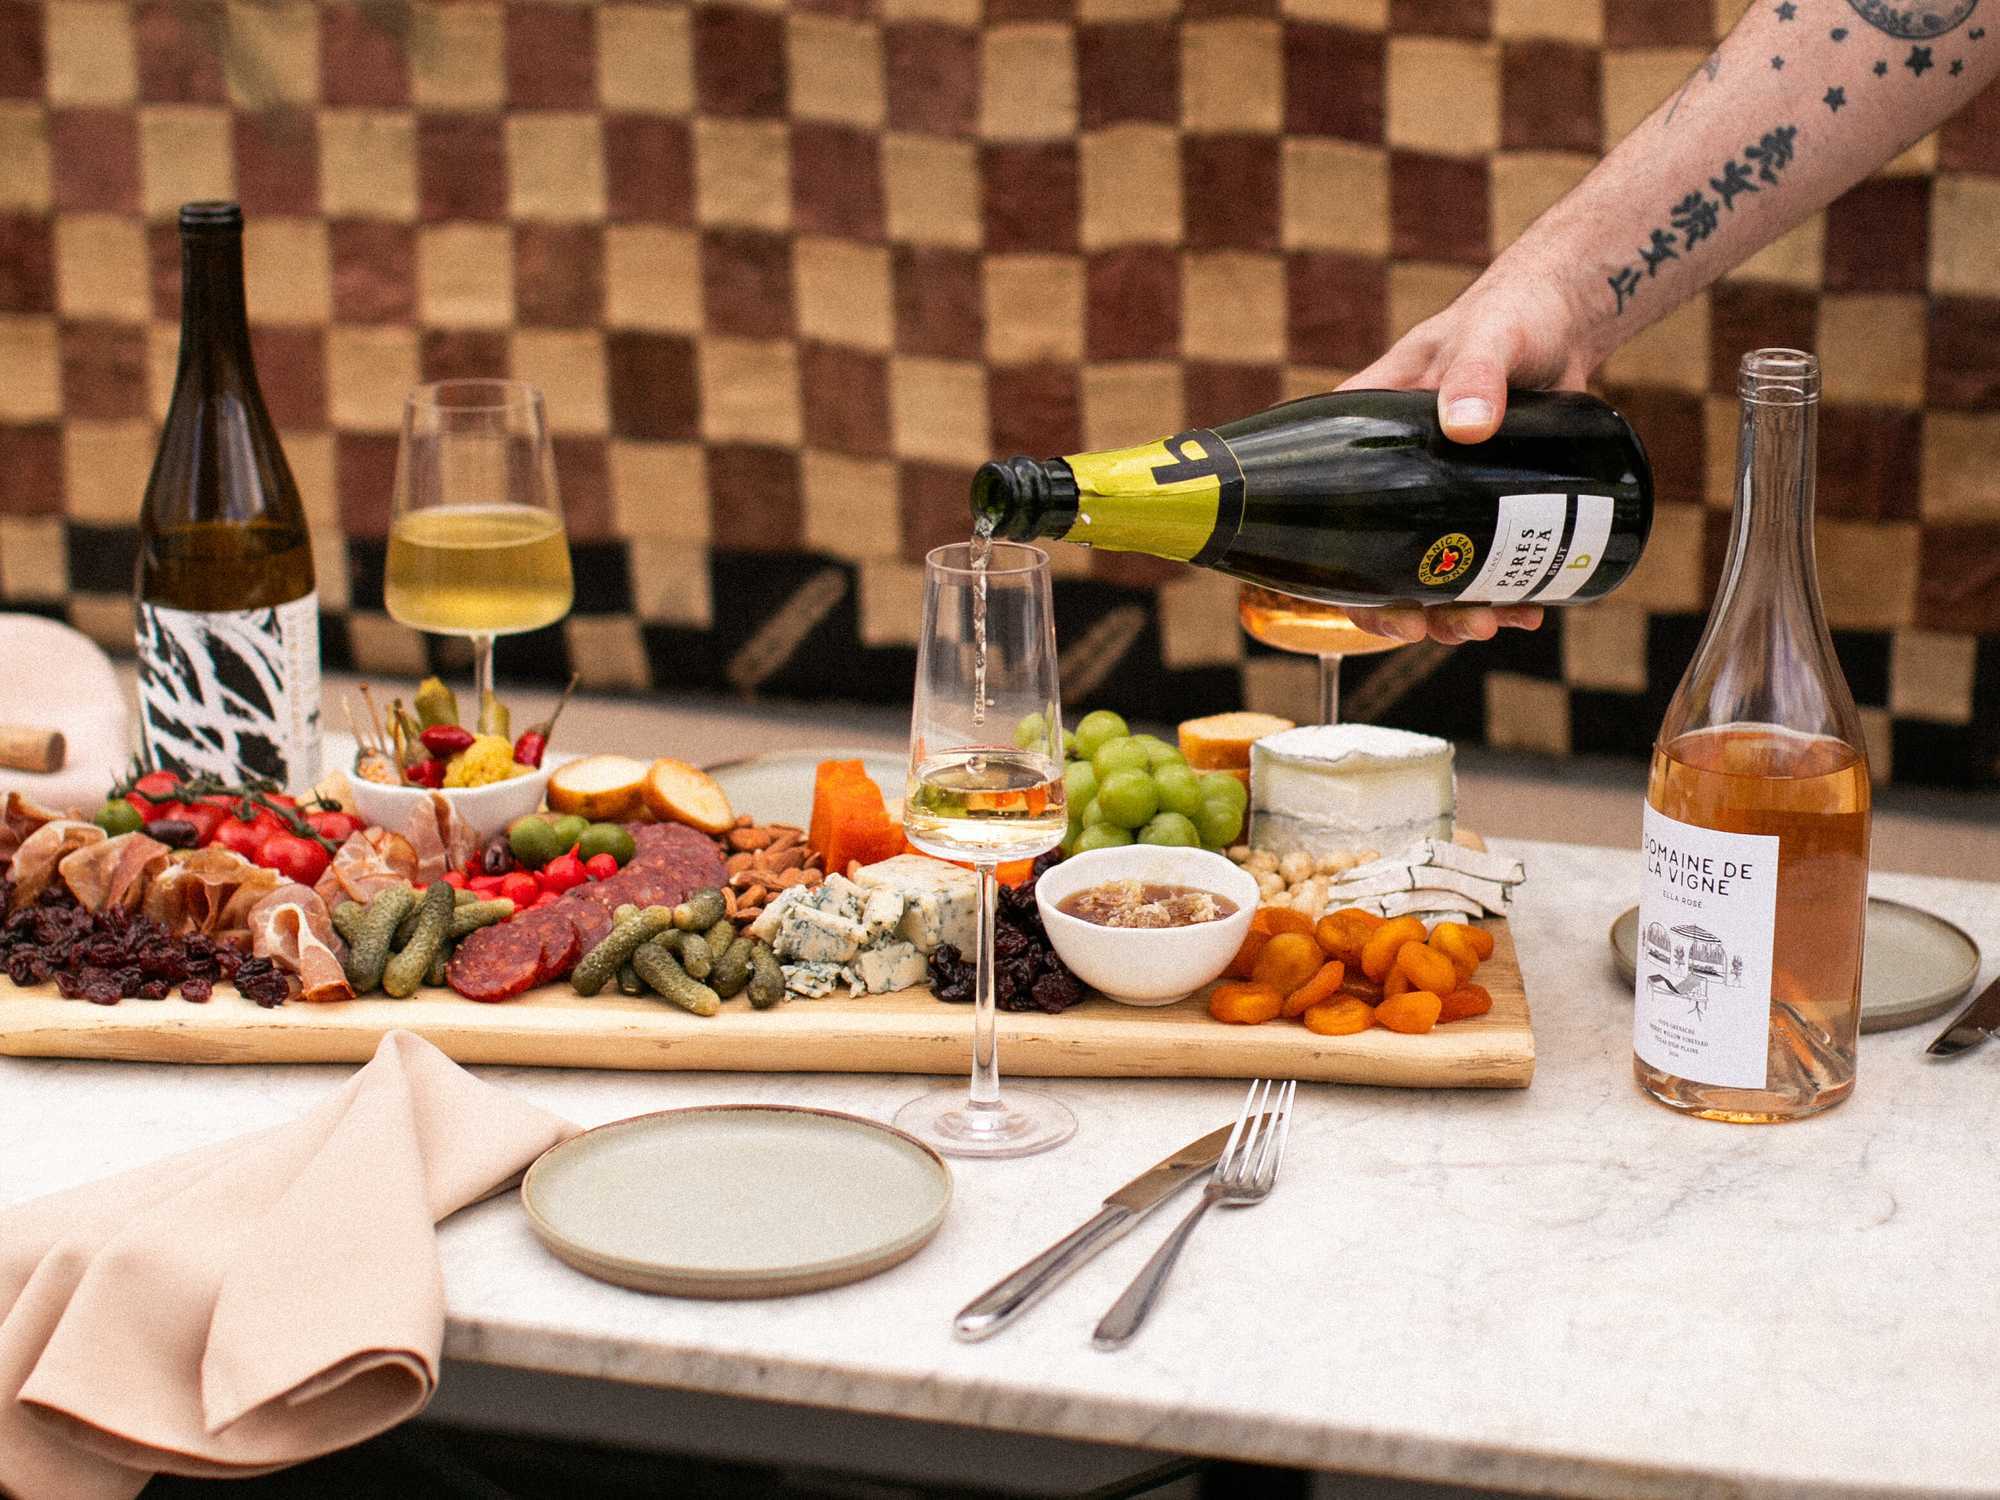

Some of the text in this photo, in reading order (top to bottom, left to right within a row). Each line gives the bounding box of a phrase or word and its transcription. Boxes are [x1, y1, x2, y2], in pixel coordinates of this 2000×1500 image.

[1420, 536, 1473, 583] ORGANIC FARMING
[1496, 528, 1535, 587] PARÉS
[1548, 547, 1568, 576] BRUT
[1648, 855, 1730, 896] LA VIGNE
[1724, 861, 1753, 880] DE
[1662, 890, 1680, 902] ELLA
